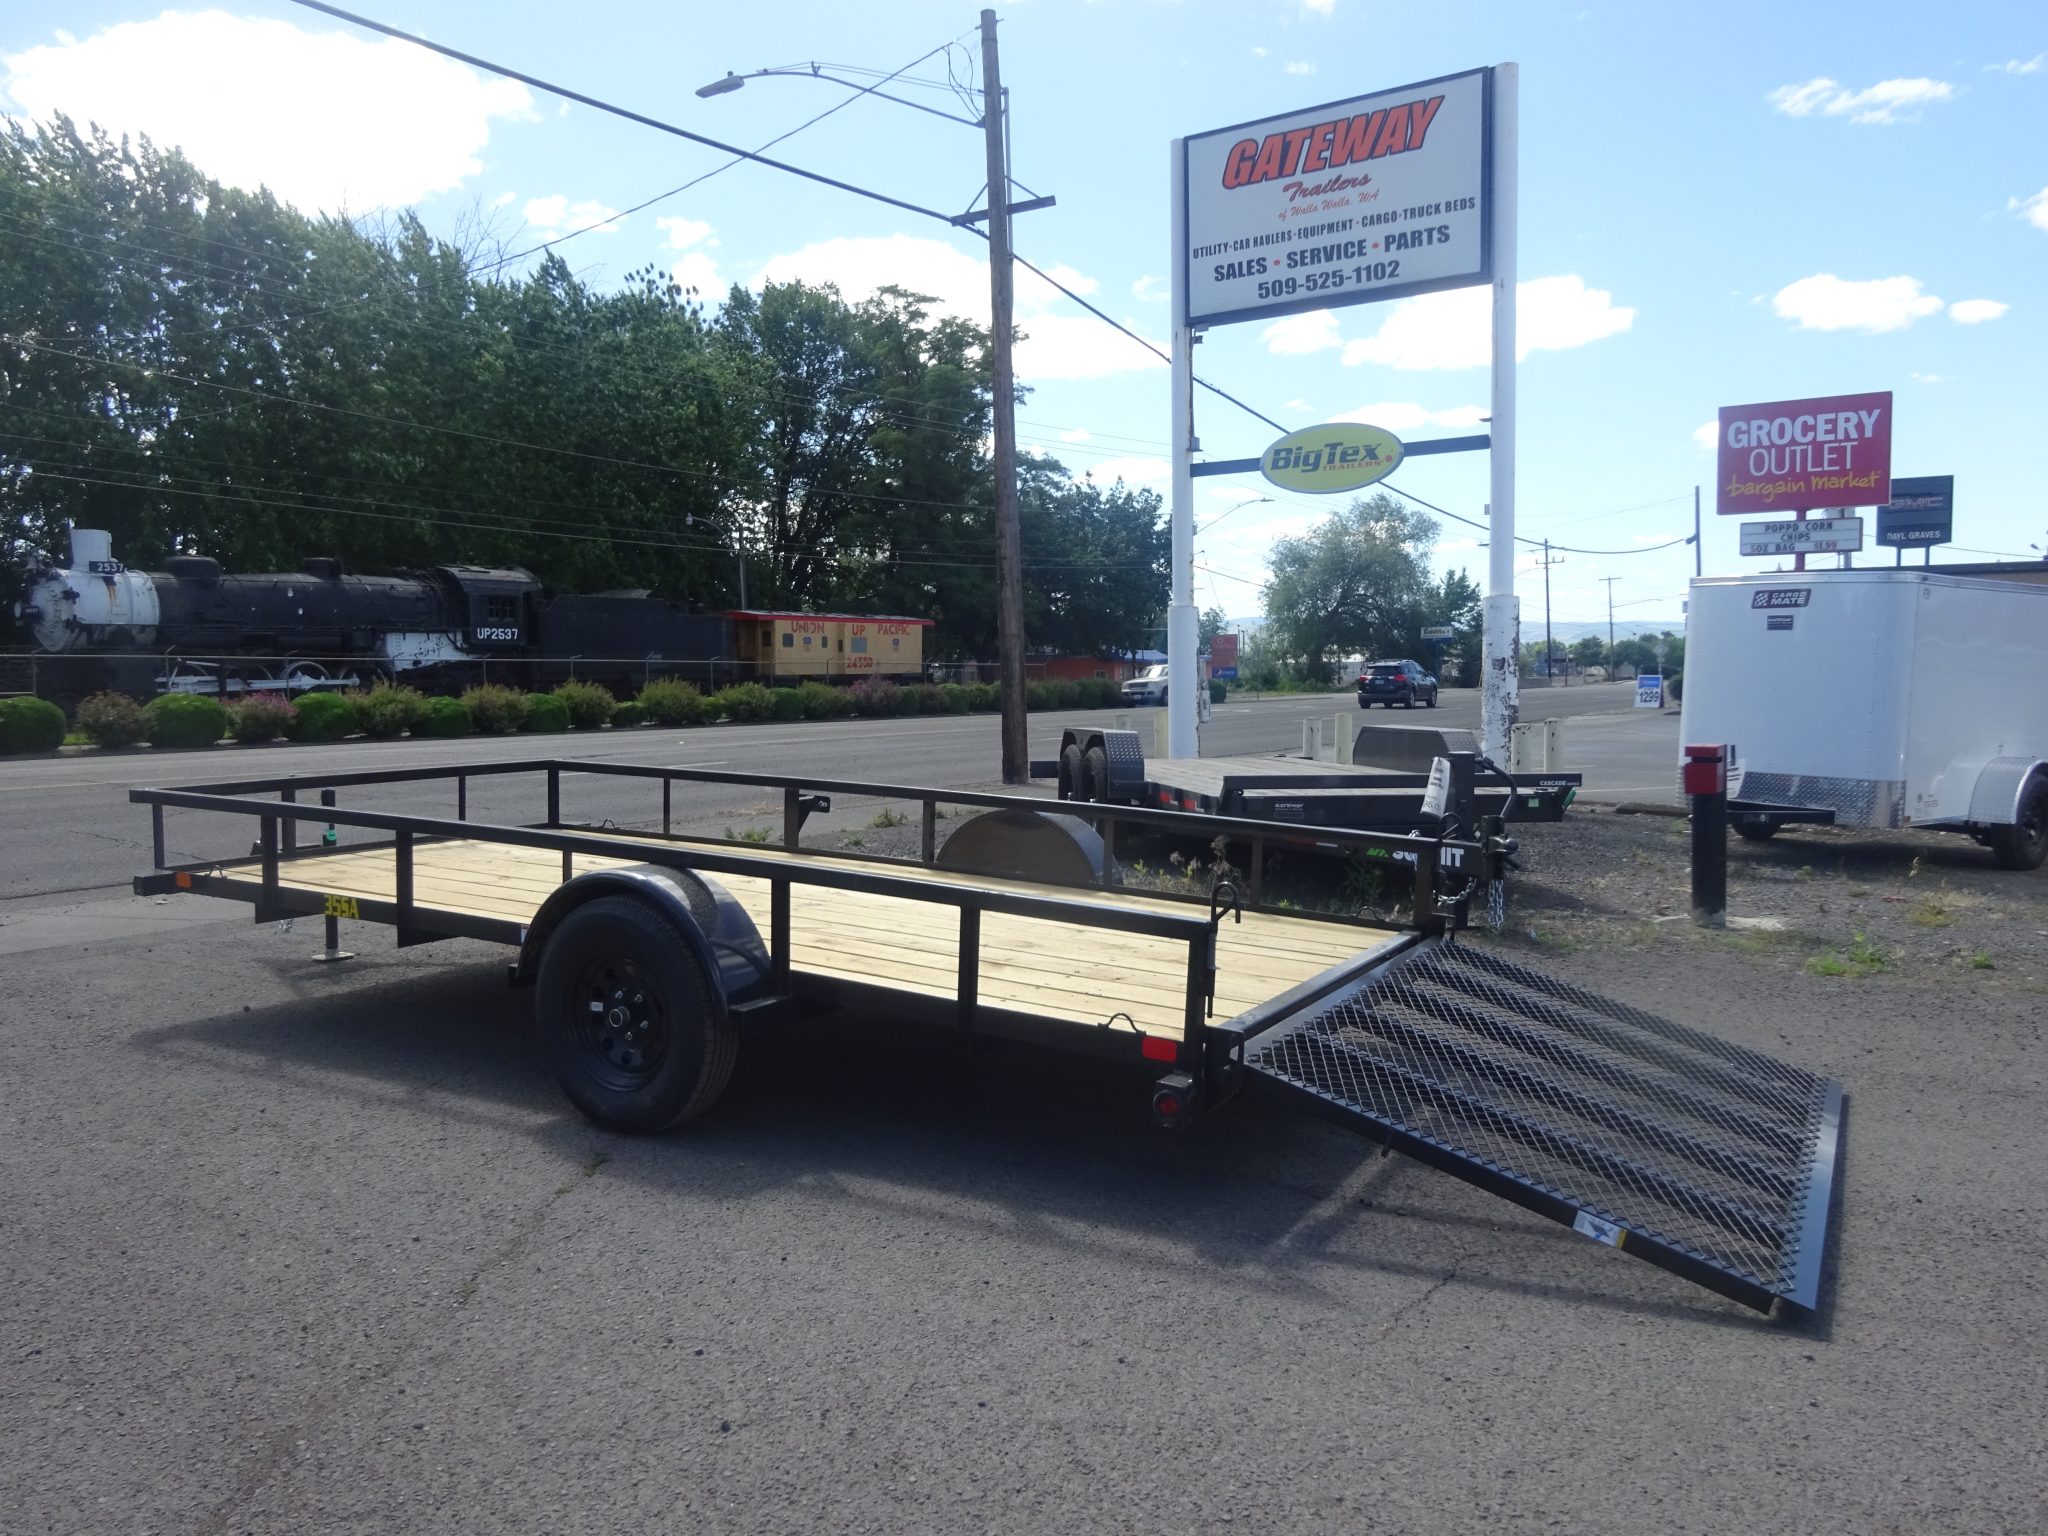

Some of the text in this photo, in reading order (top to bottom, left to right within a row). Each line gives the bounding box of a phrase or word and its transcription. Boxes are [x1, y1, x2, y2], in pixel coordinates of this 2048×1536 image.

[1222, 95, 1446, 190] GATEWAY
[1282, 174, 1372, 202] Trailers
[1278, 208, 1288, 222] of
[1290, 203, 1318, 216] Walla
[1192, 197, 1475, 259] UTILITY CAR HAULERS EQUIPMENT CARGO TRUCK BEDS
[1214, 224, 1450, 282] SALES SERVICE PARTS
[1258, 260, 1400, 299] 509-525-1102
[1727, 408, 1882, 448] GROCERY
[1750, 441, 1858, 477] OUTLET
[1322, 460, 1382, 472] TRAILERS
[1726, 470, 1879, 502] bargain market
[1805, 522, 1833, 531] CORN
[1781, 533, 1811, 542] CHIPS
[1908, 530, 1941, 539] GRAVES
[1775, 543, 1795, 552] BAG
[97, 563, 124, 572] 2537
[1771, 597, 1805, 605] MATE
[477, 627, 518, 640] UP2537
[791, 620, 825, 634] UNION
[852, 624, 866, 636] UP
[877, 623, 911, 636] PACIFIC
